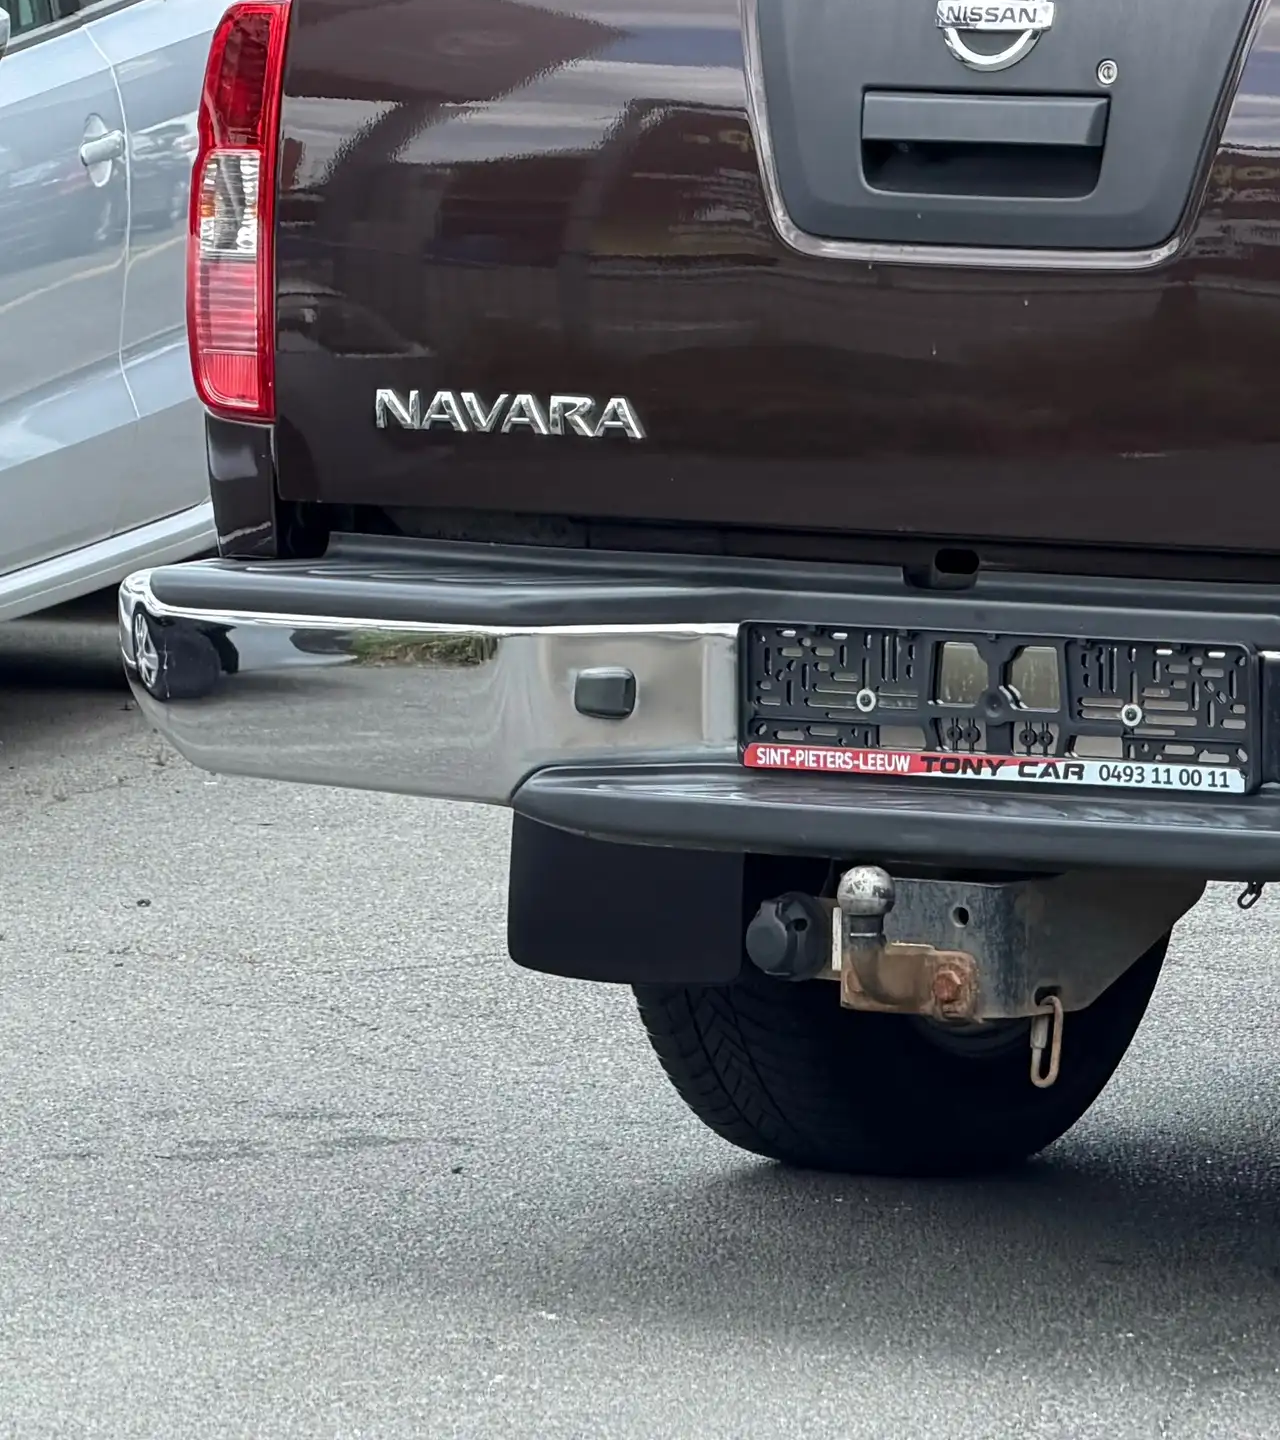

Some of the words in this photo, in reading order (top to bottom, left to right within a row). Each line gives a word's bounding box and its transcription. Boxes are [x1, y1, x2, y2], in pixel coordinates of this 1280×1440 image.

[946, 3, 1038, 25] NISSAN
[375, 388, 647, 439] NAVARA
[756, 747, 911, 773] SINT-PIETERS-LEEUW
[920, 755, 1008, 777] TONY
[1018, 761, 1085, 782] CAR
[1099, 764, 1146, 784] 0493
[1151, 767, 1174, 786] 11
[1179, 768, 1203, 787] 00
[1208, 770, 1231, 789] 11
